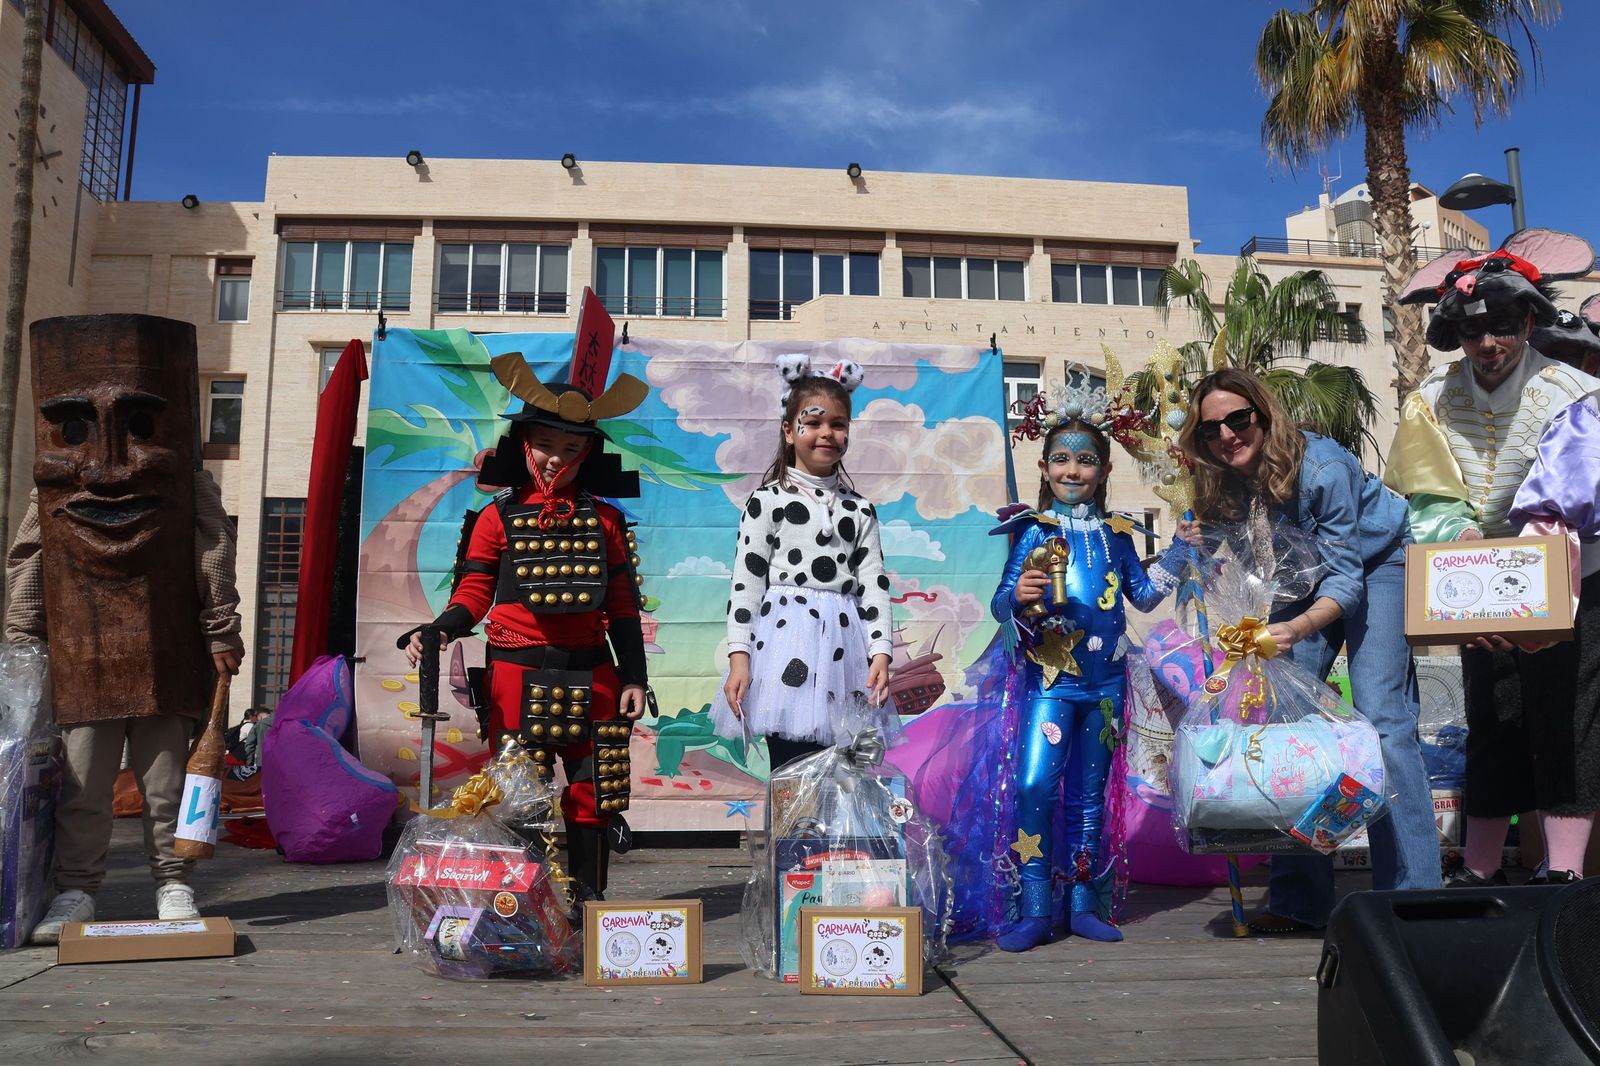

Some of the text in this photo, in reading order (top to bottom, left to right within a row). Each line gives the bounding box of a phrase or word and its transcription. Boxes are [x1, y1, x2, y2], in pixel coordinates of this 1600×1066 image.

[872, 320, 1155, 339] AYUNTAMIENTO
[1433, 553, 1496, 569] CARNAVAL
[1473, 610, 1512, 618] PREMIO
[1434, 799, 1458, 809] GRAM
[440, 867, 491, 882] KALEIDOS
[602, 914, 671, 929] CARNAVAL 2026
[817, 922, 889, 938] CARNAVAL 2026
[633, 969, 662, 977] PREMIO
[849, 980, 879, 988] PREMIO
